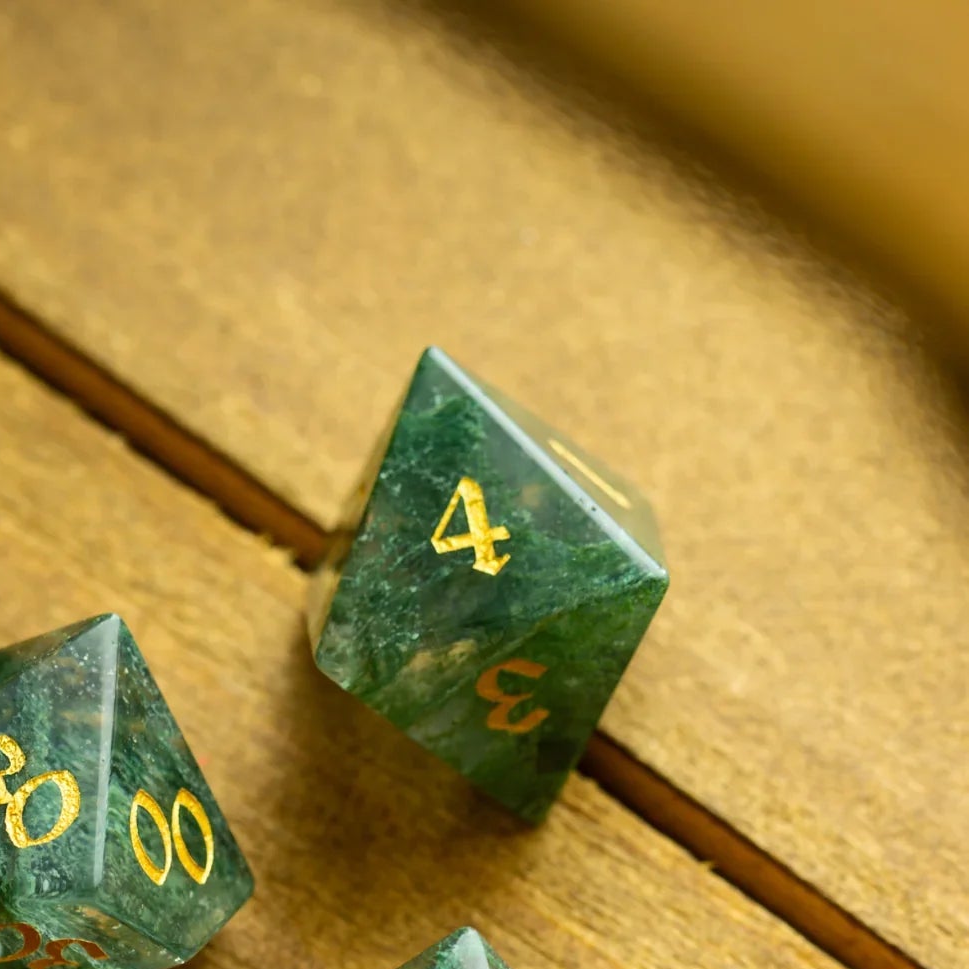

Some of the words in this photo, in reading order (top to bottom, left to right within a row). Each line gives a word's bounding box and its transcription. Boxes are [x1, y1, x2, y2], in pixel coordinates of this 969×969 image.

[431, 476, 511, 576] 4
[475, 658, 549, 734] 3
[129, 787, 215, 886] 00
